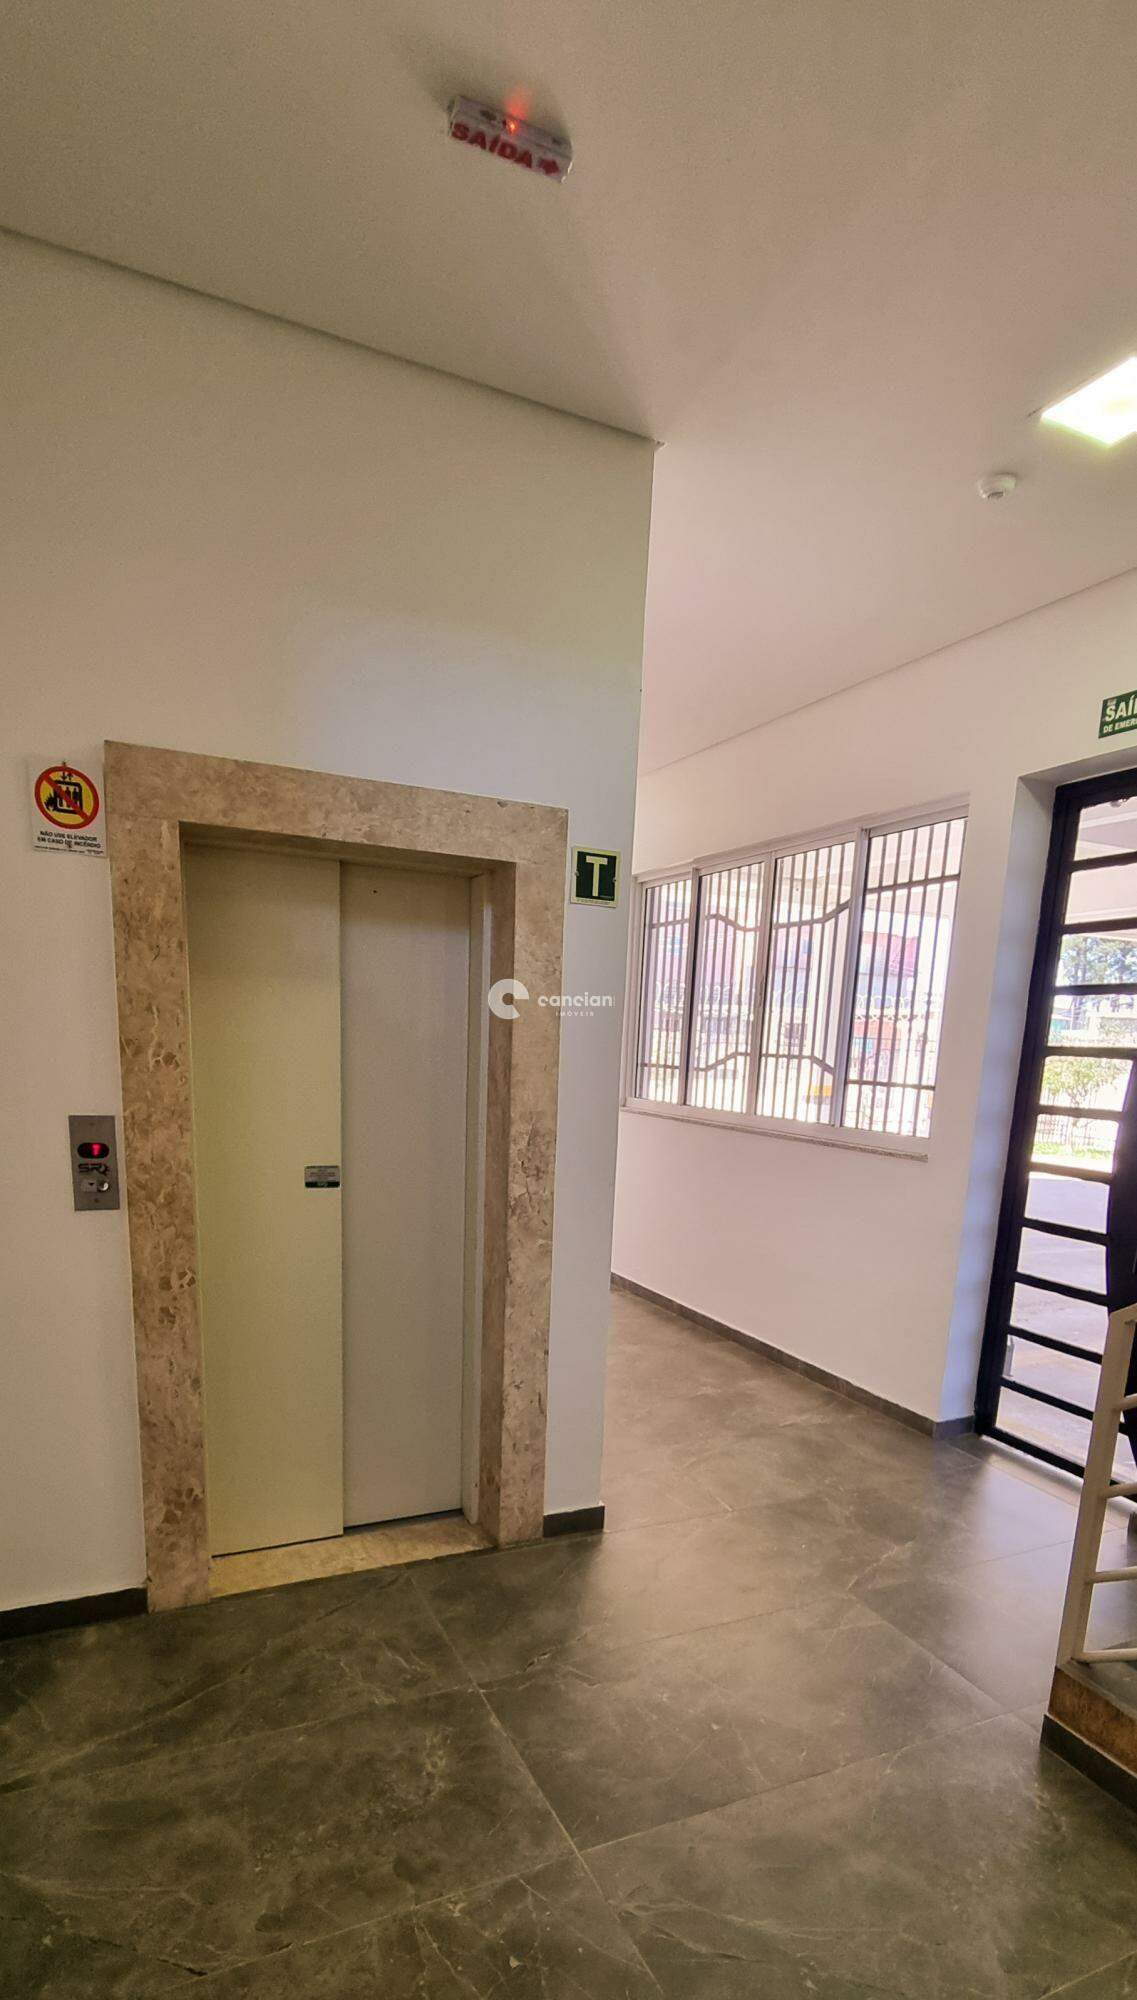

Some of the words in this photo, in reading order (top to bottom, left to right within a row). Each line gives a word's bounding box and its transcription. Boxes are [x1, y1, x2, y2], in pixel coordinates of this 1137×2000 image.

[451, 123, 533, 168] SAÍDA
[1103, 724, 1113, 734] DE
[586, 855, 608, 896] T
